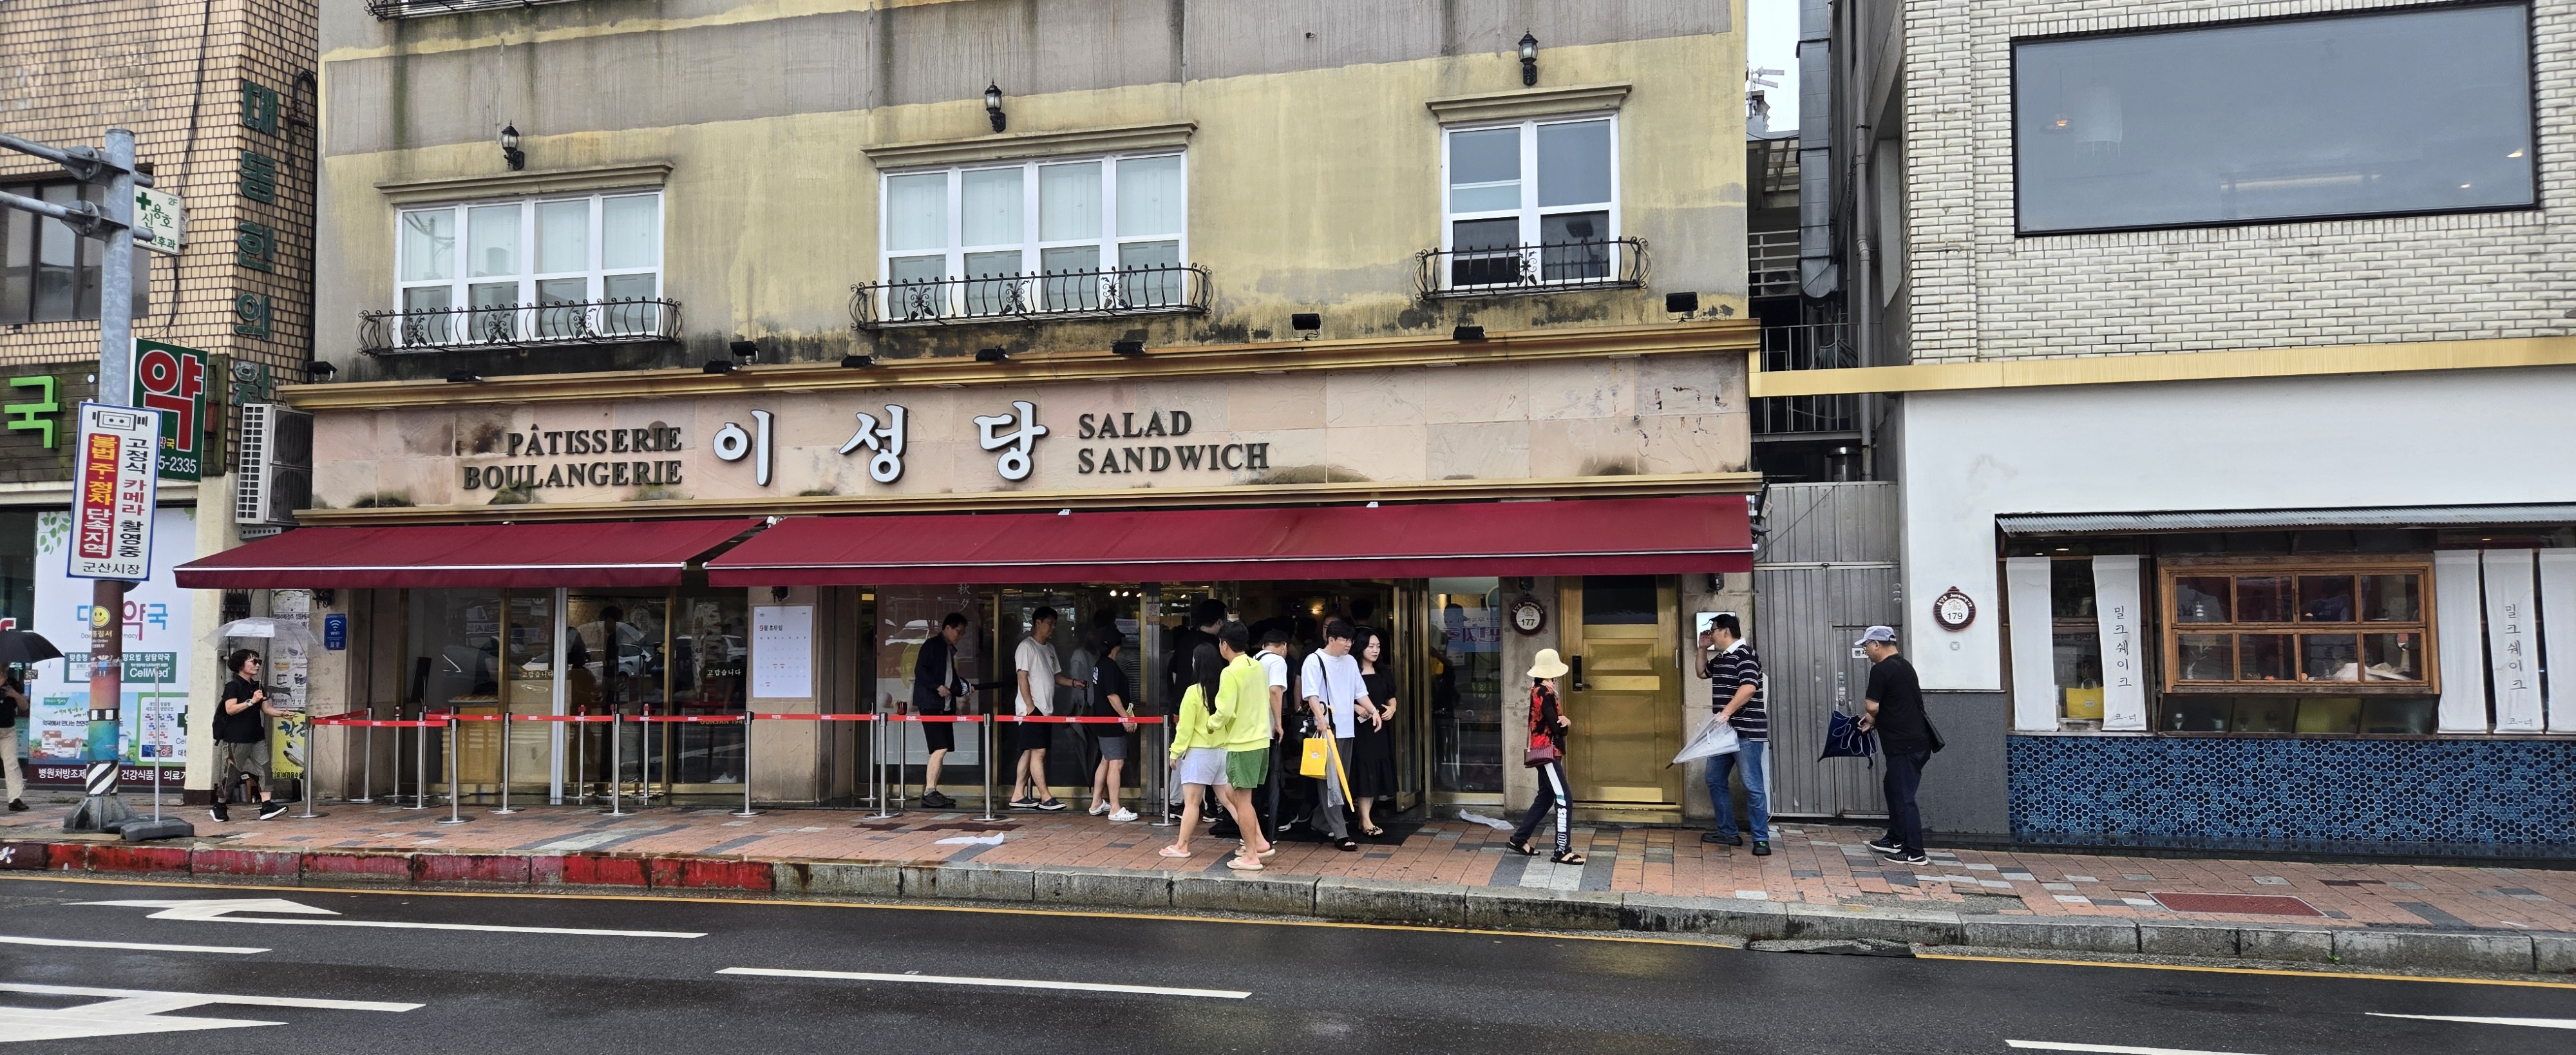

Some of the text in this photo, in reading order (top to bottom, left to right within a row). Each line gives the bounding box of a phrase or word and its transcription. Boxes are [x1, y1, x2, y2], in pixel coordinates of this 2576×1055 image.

[168, 197, 178, 206] 2F
[4, 375, 65, 450] 국
[138, 349, 204, 452] 약
[507, 423, 682, 456] PÂTISSERIE
[1079, 410, 1191, 439] SALAD
[91, 435, 117, 461] 불법
[1079, 442, 1270, 474] SANDWICH
[463, 460, 683, 490] BOULANGERIE
[117, 437, 149, 558] 고정식 카메라 촬영중
[83, 508, 112, 556] 단속지역
[82, 562, 140, 575] 군산시장
[70, 653, 88, 661] 맞춤형
[145, 653, 170, 661] 상담약국
[2114, 605, 2132, 687] 밀크쉐이크
[2505, 604, 2528, 690] 밀크쉐이크
[129, 667, 169, 678] CellMed
[39, 768, 87, 779] 병원처방조제
[121, 770, 155, 781] 건강식품
